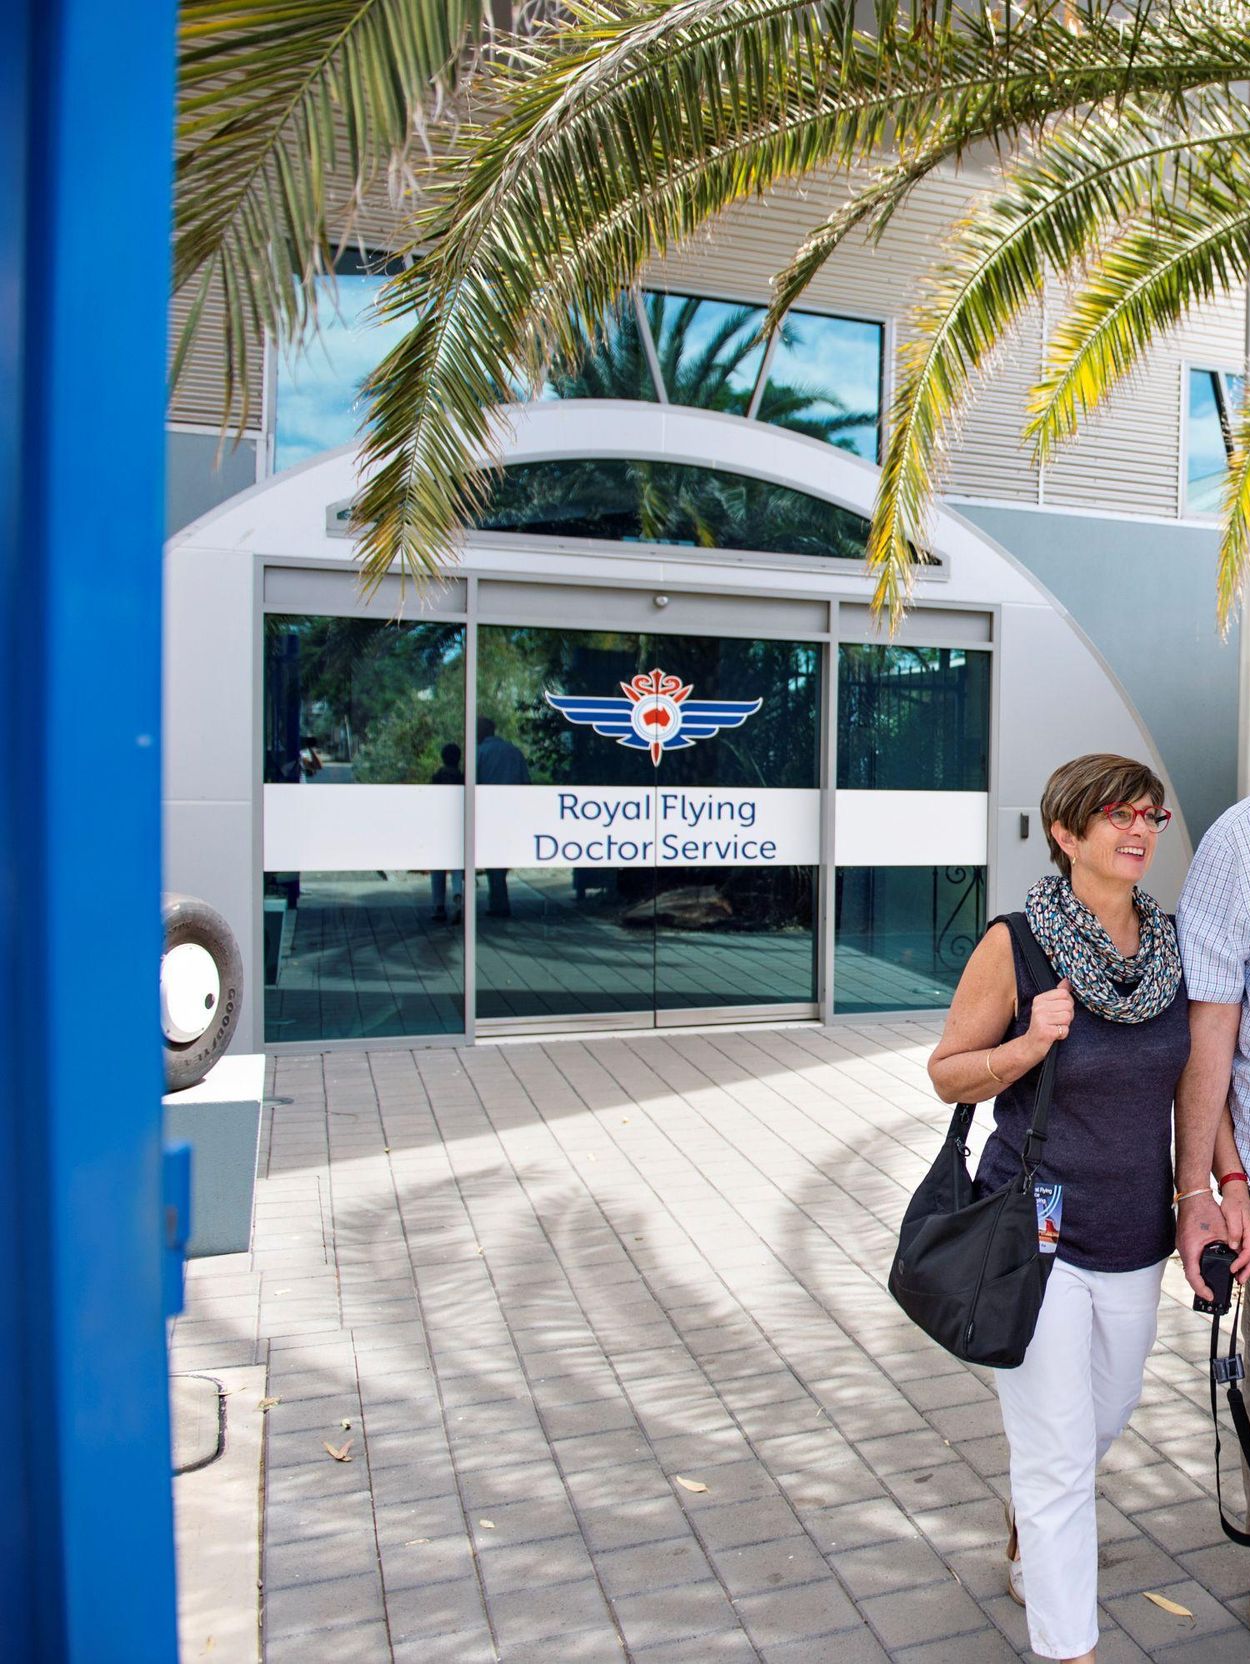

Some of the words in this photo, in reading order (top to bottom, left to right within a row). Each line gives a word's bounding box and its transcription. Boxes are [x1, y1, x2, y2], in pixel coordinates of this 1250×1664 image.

[558, 793, 650, 827] Royal
[661, 794, 757, 827] Flying
[534, 834, 653, 861] Doctor
[662, 834, 777, 861] Service
[175, 988, 236, 1067] GOODYEA
